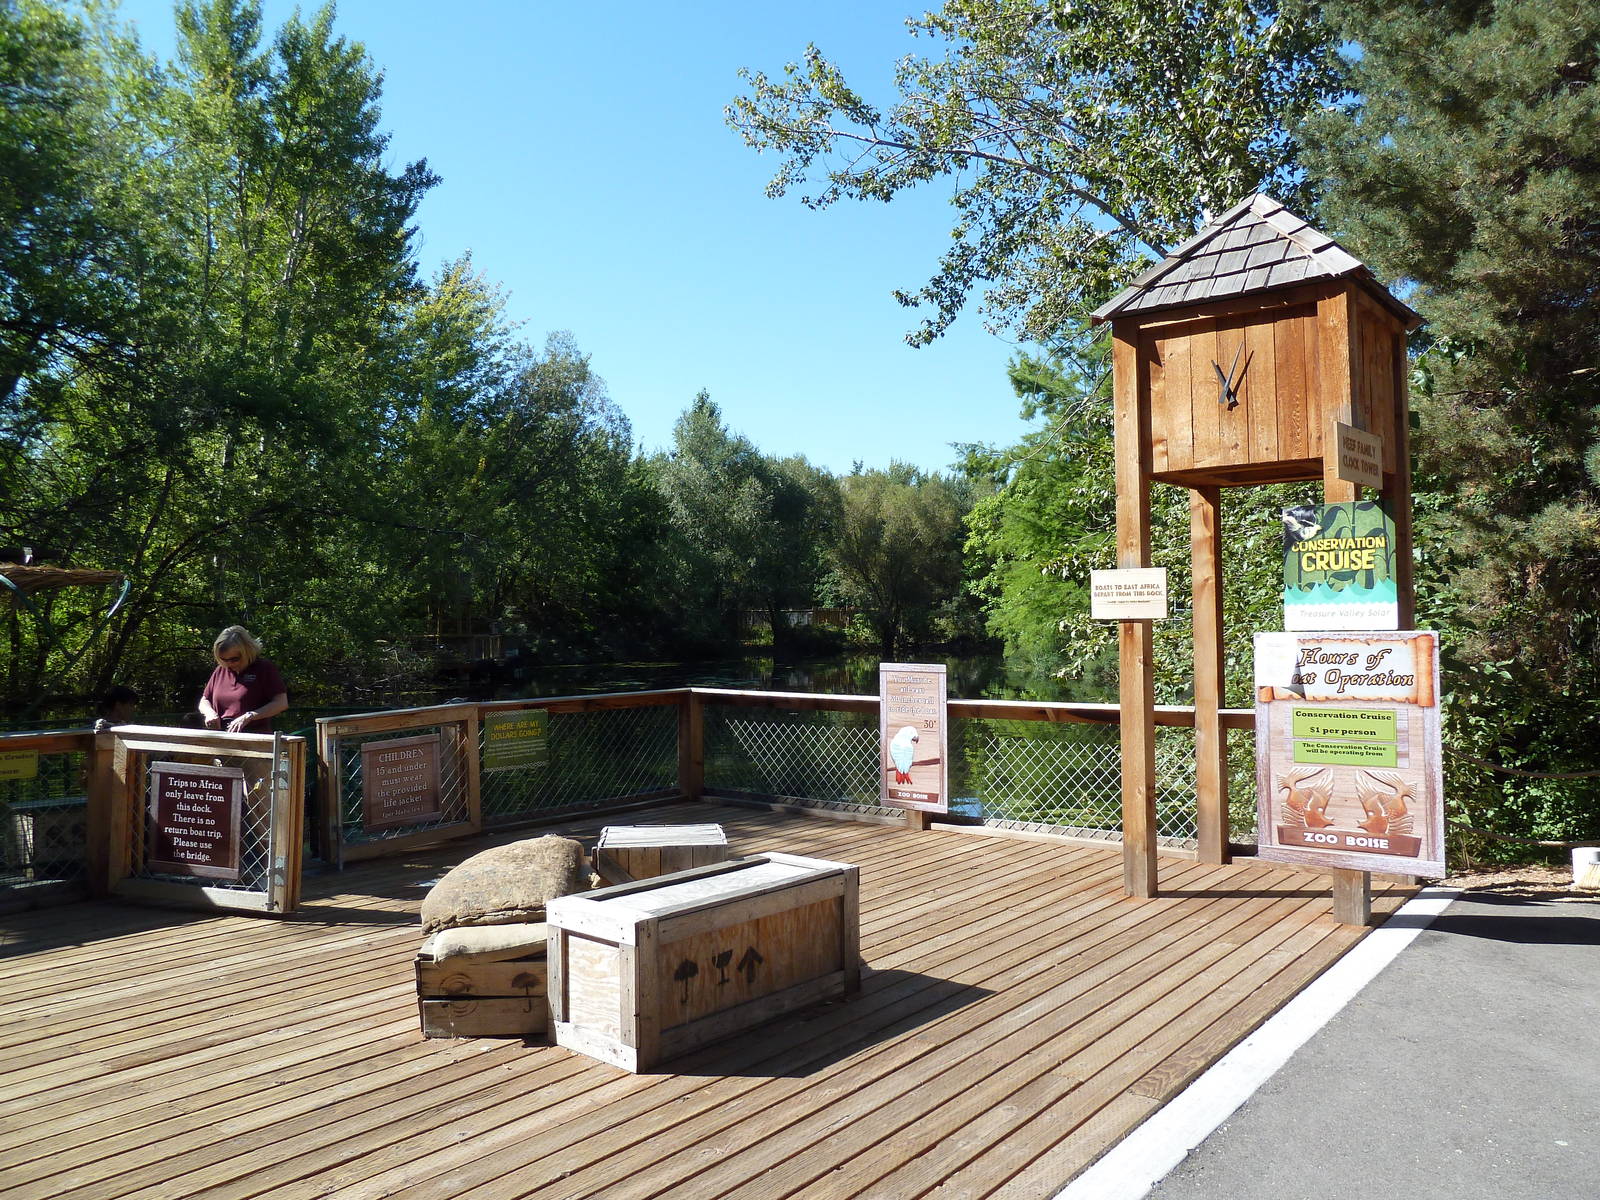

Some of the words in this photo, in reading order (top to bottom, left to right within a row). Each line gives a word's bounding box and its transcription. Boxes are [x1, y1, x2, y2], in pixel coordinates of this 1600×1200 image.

[1357, 440, 1376, 459] FAMILY
[1342, 454, 1360, 472] CLOCK
[1360, 460, 1379, 477] TOWER
[1292, 536, 1386, 552] CONSERVATION
[1301, 549, 1376, 572] CRUISE
[1300, 610, 1335, 618] Treasure
[1340, 609, 1364, 618] Valley
[1368, 609, 1390, 617] Solar
[1298, 647, 1359, 667] Hours
[1366, 648, 1392, 670] of
[1292, 673, 1317, 686] oat
[1324, 668, 1414, 693] Operation
[1295, 711, 1358, 720] Conservation
[379, 748, 424, 762] CHILDREN
[376, 767, 385, 776] 15
[387, 764, 402, 774] and
[404, 762, 427, 772] under
[168, 777, 188, 788] Trips
[199, 780, 223, 790] Africa
[382, 777, 400, 786] must
[402, 774, 423, 782] wear
[165, 790, 182, 799] only
[184, 791, 204, 800] leave
[206, 793, 224, 802] from
[378, 789, 391, 798] the
[392, 782, 427, 796] provided
[176, 802, 190, 811] this
[192, 804, 212, 813] dock.
[384, 798, 397, 808] life
[399, 795, 422, 806] jacket
[173, 813, 196, 823] There
[190, 827, 205, 836] boat
[207, 830, 222, 839] trip.
[173, 837, 198, 848] Please
[1304, 832, 1338, 844] ZOO
[1346, 836, 1389, 849] BOISE
[174, 849, 185, 858] the
[186, 850, 211, 862] bridge.
